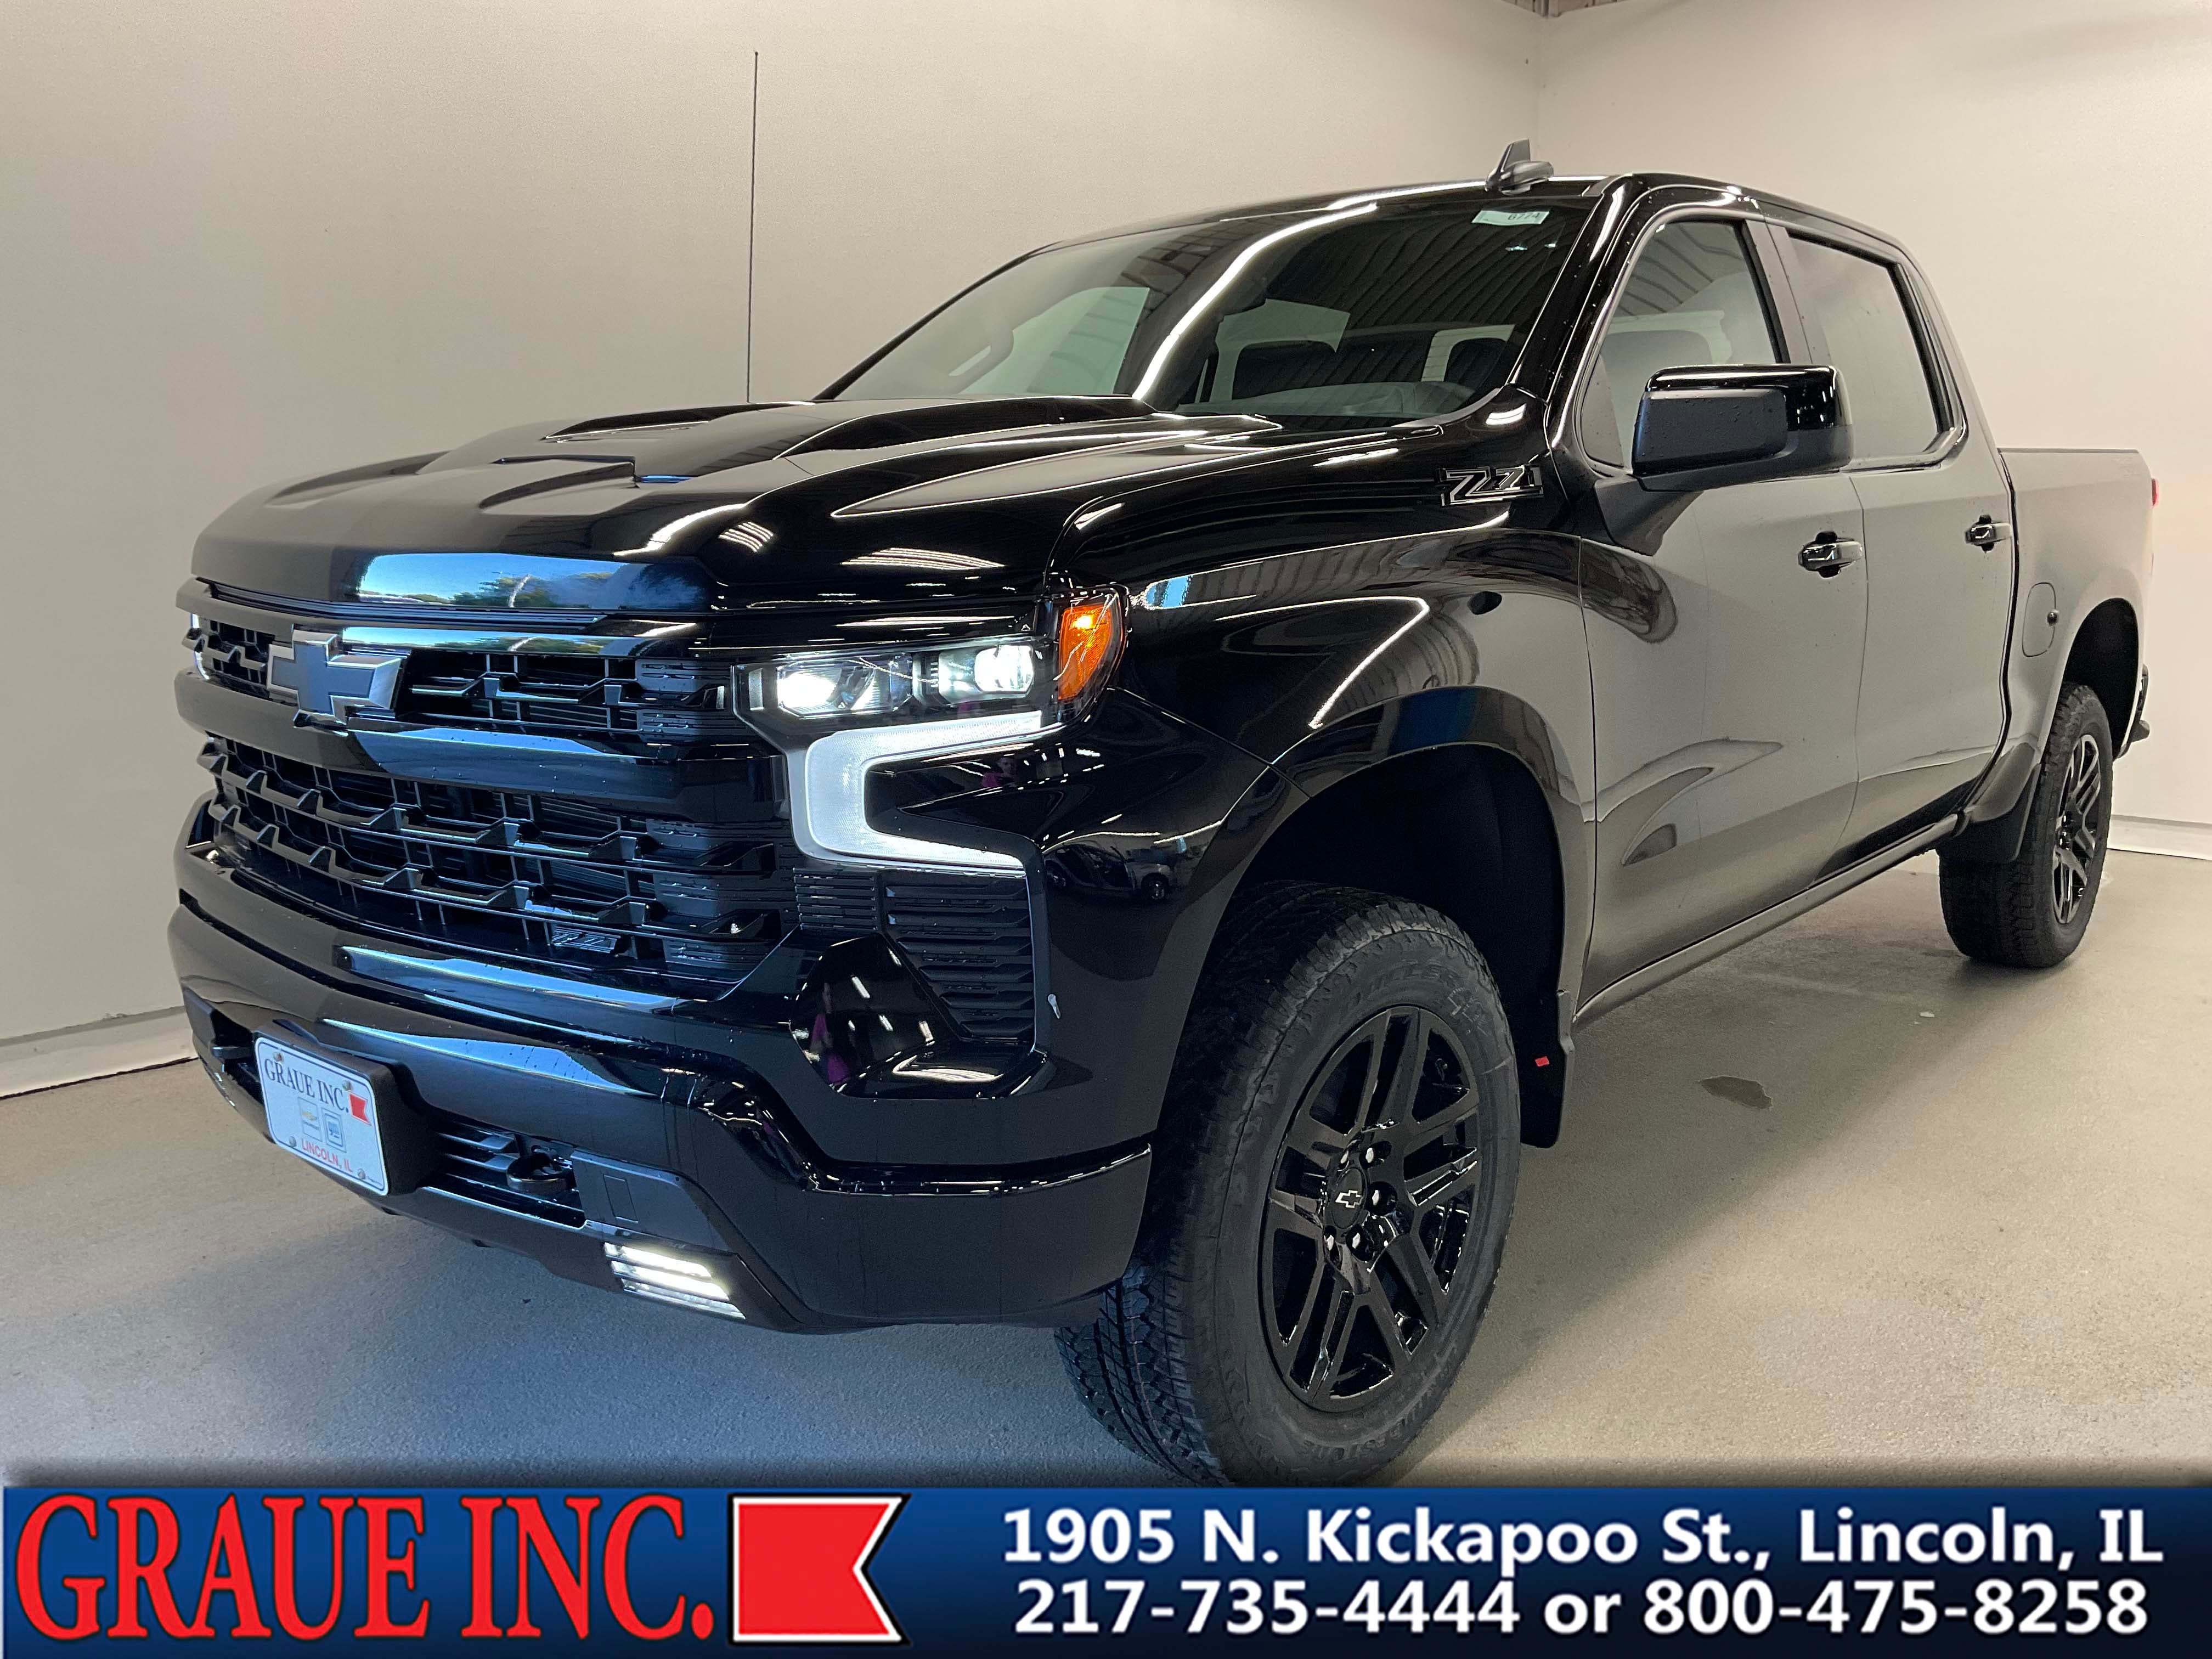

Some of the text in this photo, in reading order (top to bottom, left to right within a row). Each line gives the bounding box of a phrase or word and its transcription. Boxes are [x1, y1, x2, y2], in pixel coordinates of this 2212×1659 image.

[1436, 465, 1544, 507] Z71
[264, 1058, 349, 1113] GRAUE INC.
[302, 1140, 353, 1173] LINCOLN, IL
